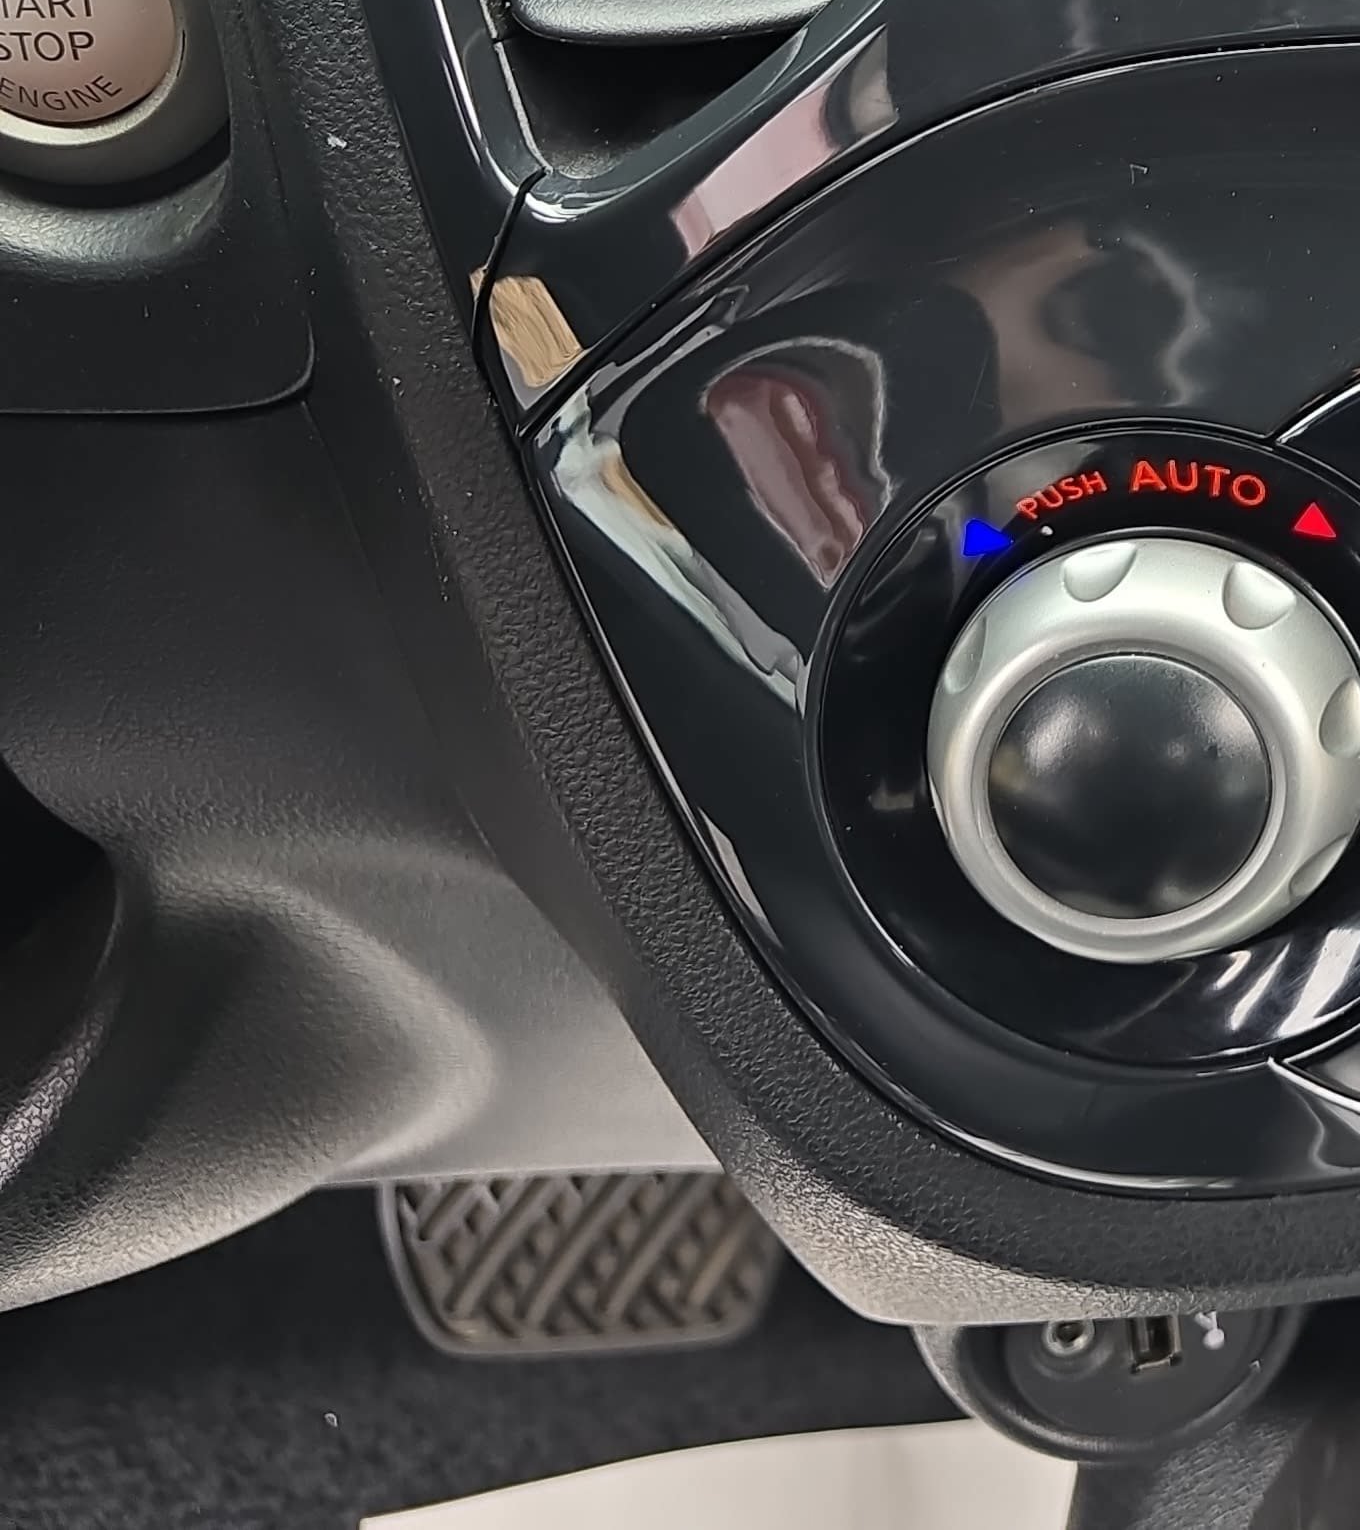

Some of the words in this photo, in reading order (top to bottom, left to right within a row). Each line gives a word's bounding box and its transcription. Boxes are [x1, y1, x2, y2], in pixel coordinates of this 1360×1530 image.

[0, 74, 123, 111] ENGINE
[1014, 470, 1109, 521] PUSH
[1128, 459, 1268, 506] AUTO
